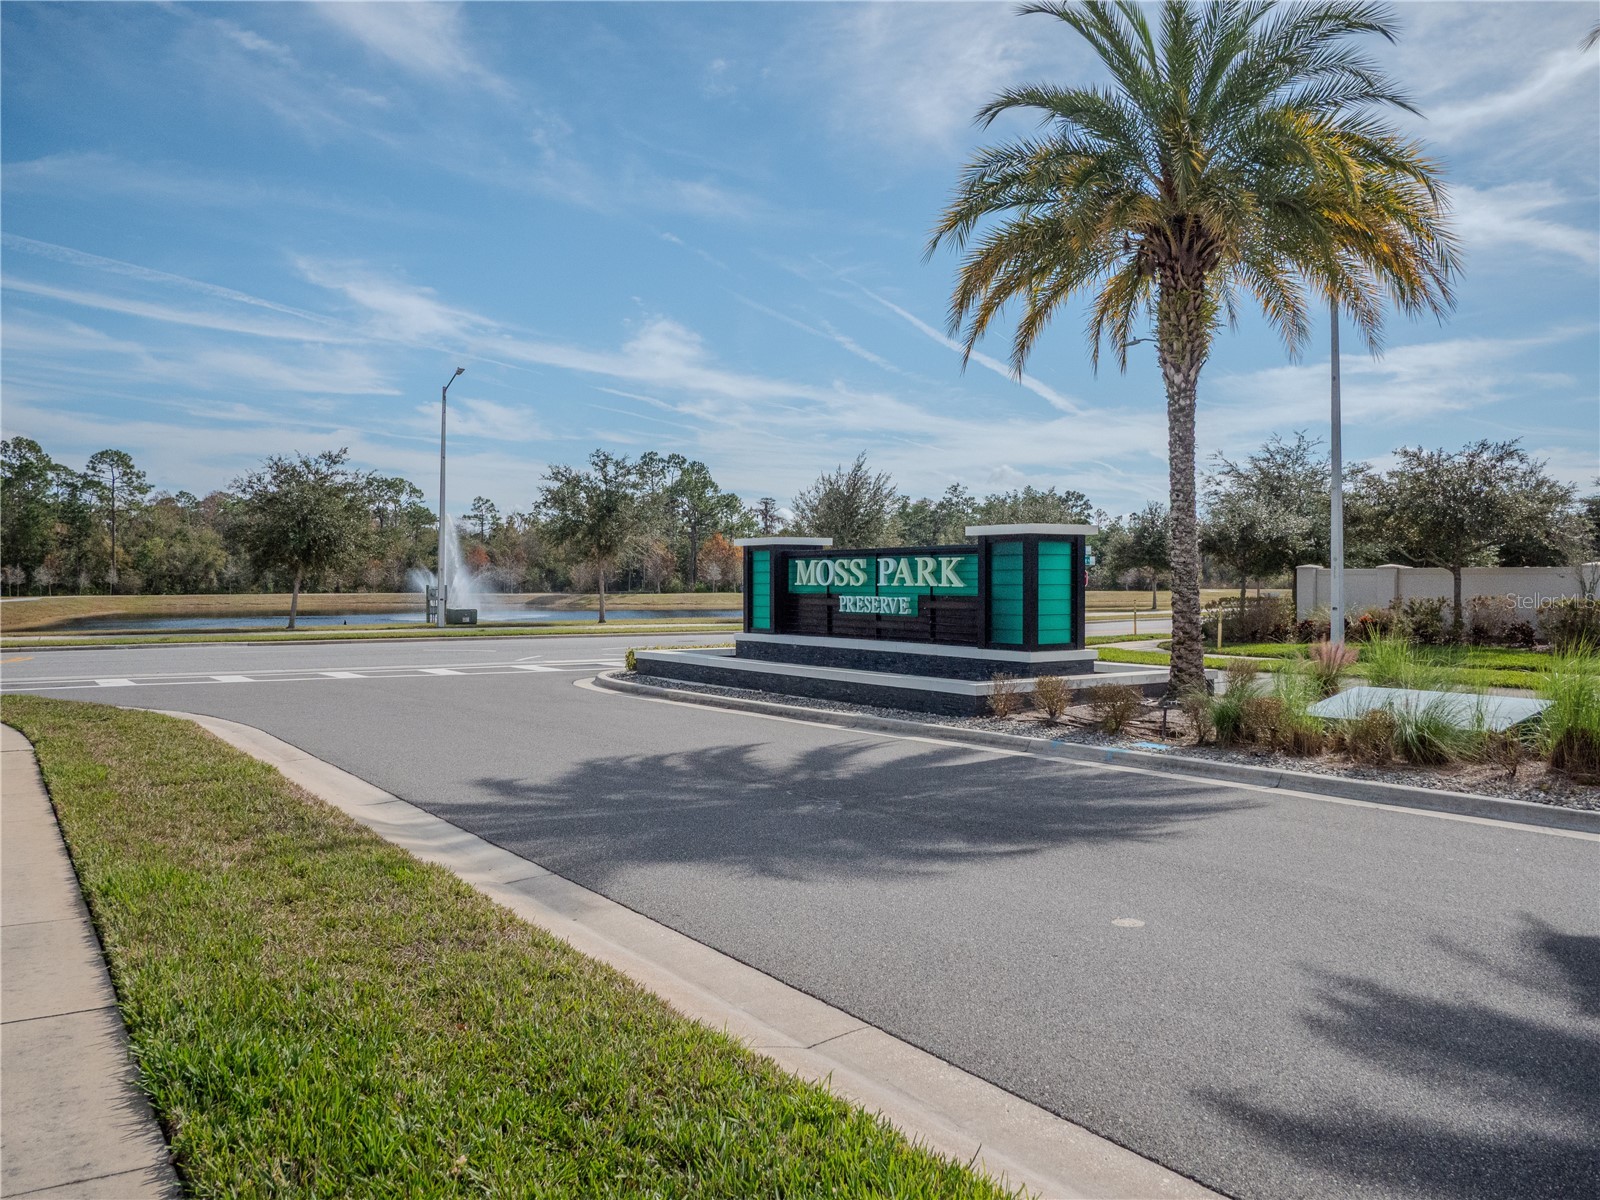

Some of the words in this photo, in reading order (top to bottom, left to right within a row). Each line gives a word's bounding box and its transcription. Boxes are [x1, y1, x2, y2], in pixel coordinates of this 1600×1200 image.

[794, 559, 867, 587] MOSS
[877, 557, 966, 588] PARK
[838, 596, 911, 615] PRESERVE
